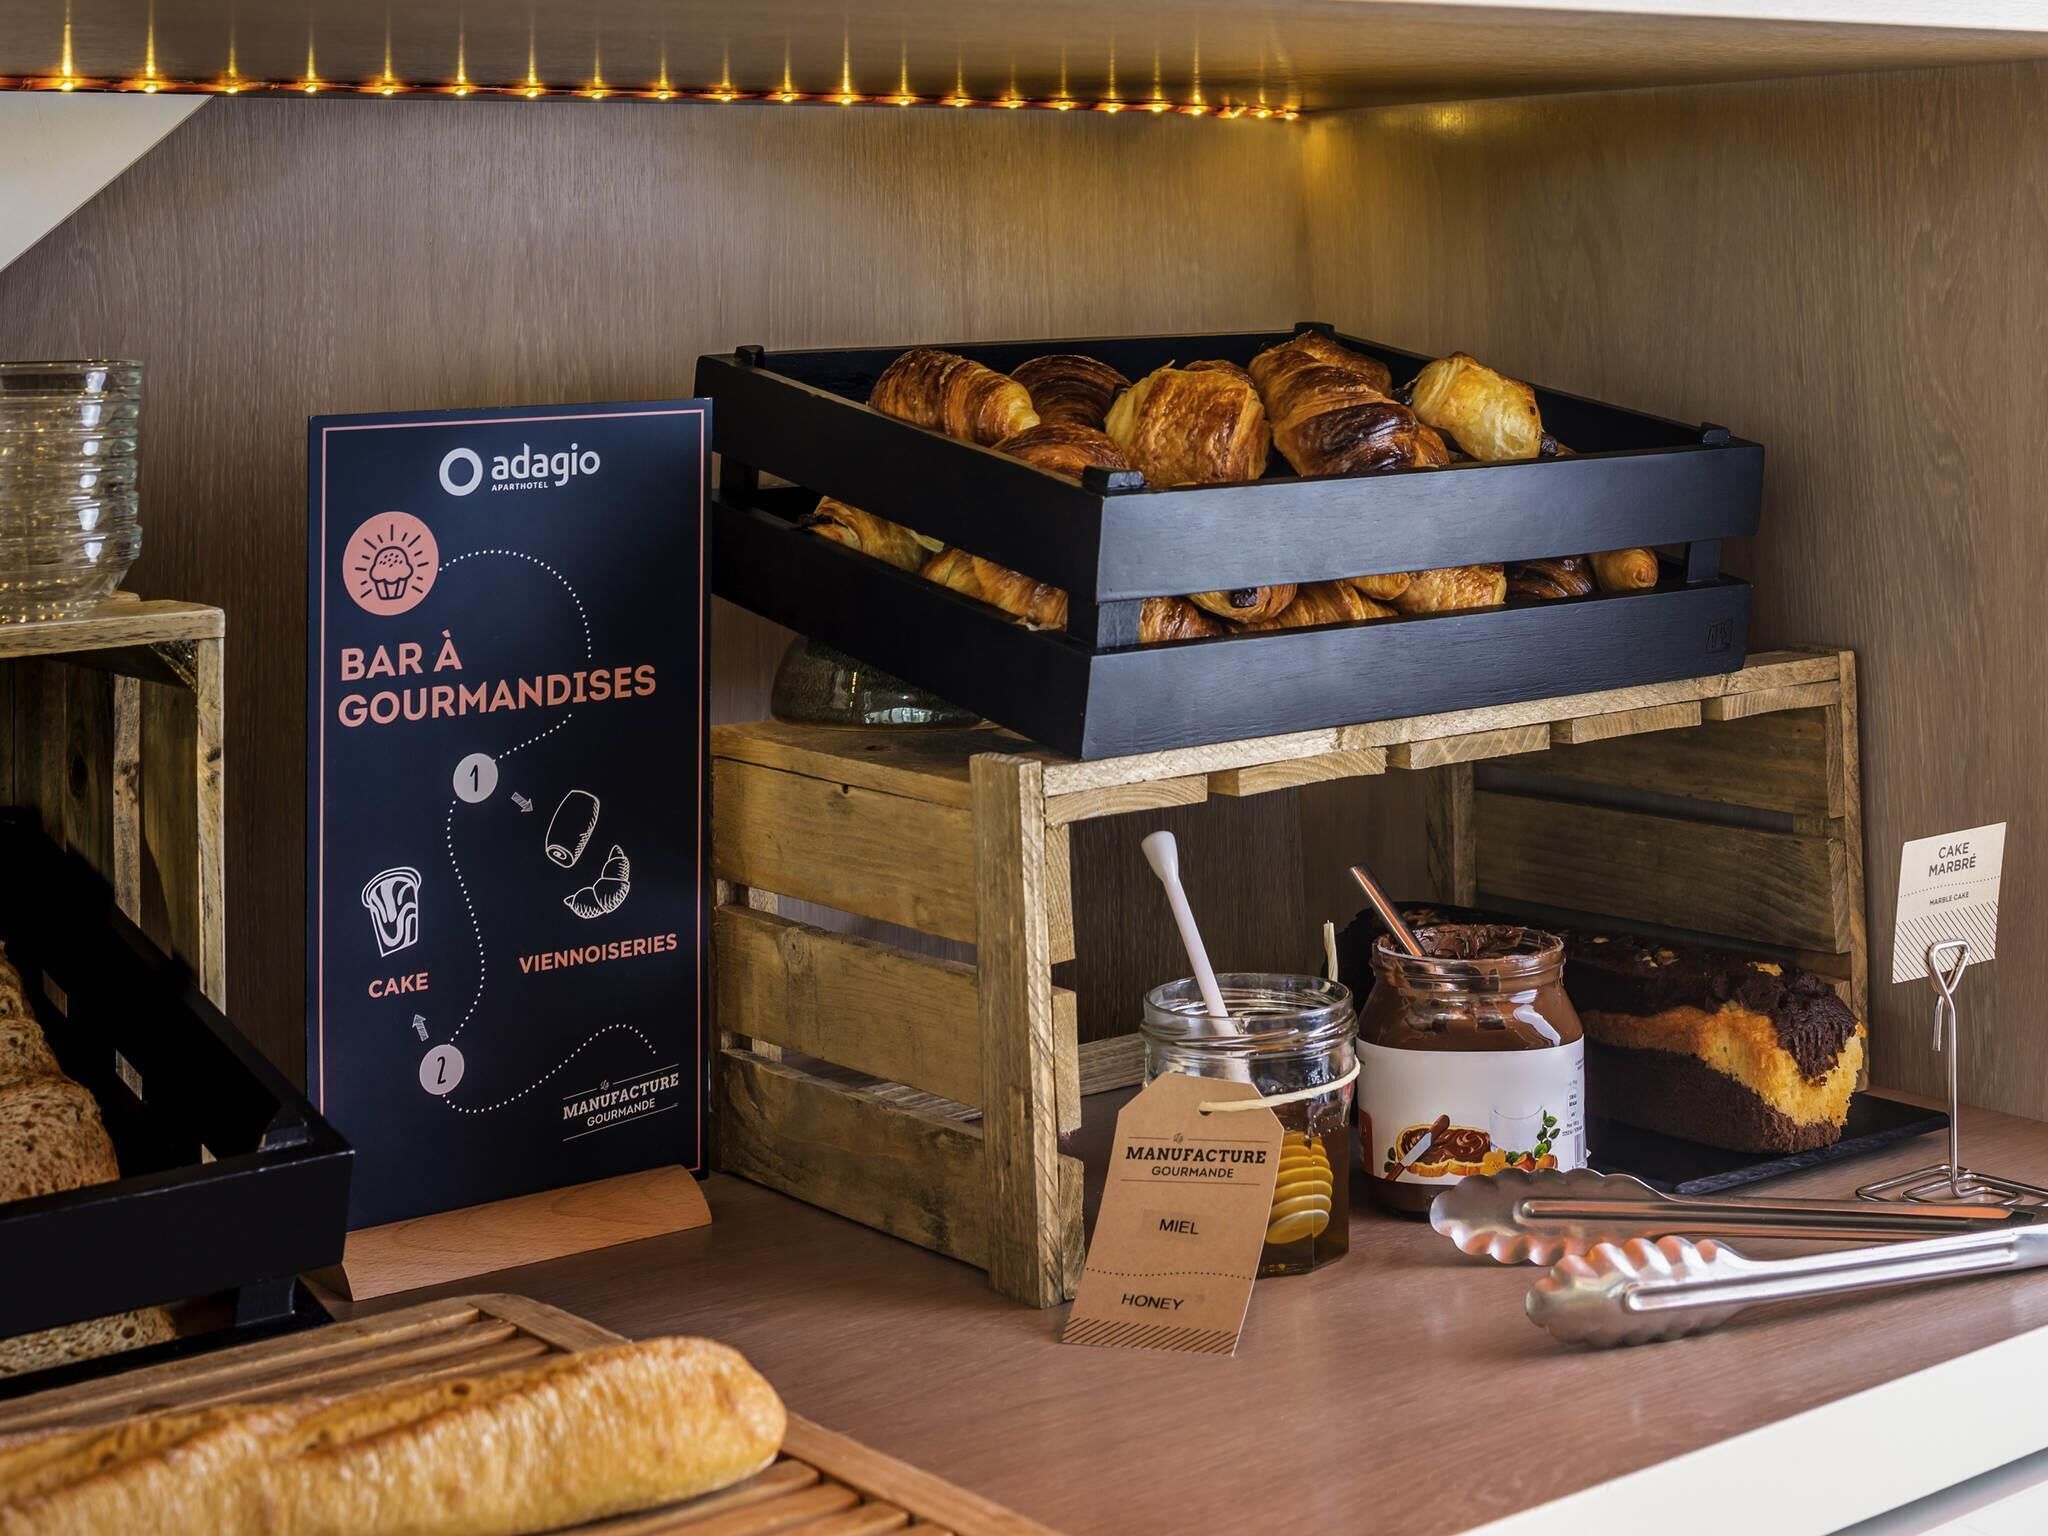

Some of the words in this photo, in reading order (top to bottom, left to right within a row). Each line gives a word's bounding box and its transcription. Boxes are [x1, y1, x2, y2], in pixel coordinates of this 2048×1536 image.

[491, 442, 600, 487] adagio
[491, 481, 549, 492] APARTHOTEL
[340, 642, 424, 682] BAR
[433, 629, 464, 674] À
[338, 665, 657, 728] GOURMANDISES
[469, 764, 480, 793] 1
[1938, 841, 1970, 859] CAKE
[1928, 853, 1976, 877] MARBRÉ
[1929, 895, 1953, 905] MARBLE
[1953, 891, 1969, 901] CAKE
[519, 932, 678, 975] VIENNOISERIES
[368, 971, 429, 999] CAKE
[436, 1056, 447, 1085] 2
[562, 1072, 680, 1121] MANUFACTURE
[586, 1097, 656, 1127] GOURMANDE
[1125, 1146, 1267, 1164] MANUFACTURE
[1151, 1165, 1234, 1178] GOURMANDE
[1159, 1218, 1200, 1236] MIEL
[1120, 1293, 1185, 1311] HONEY
